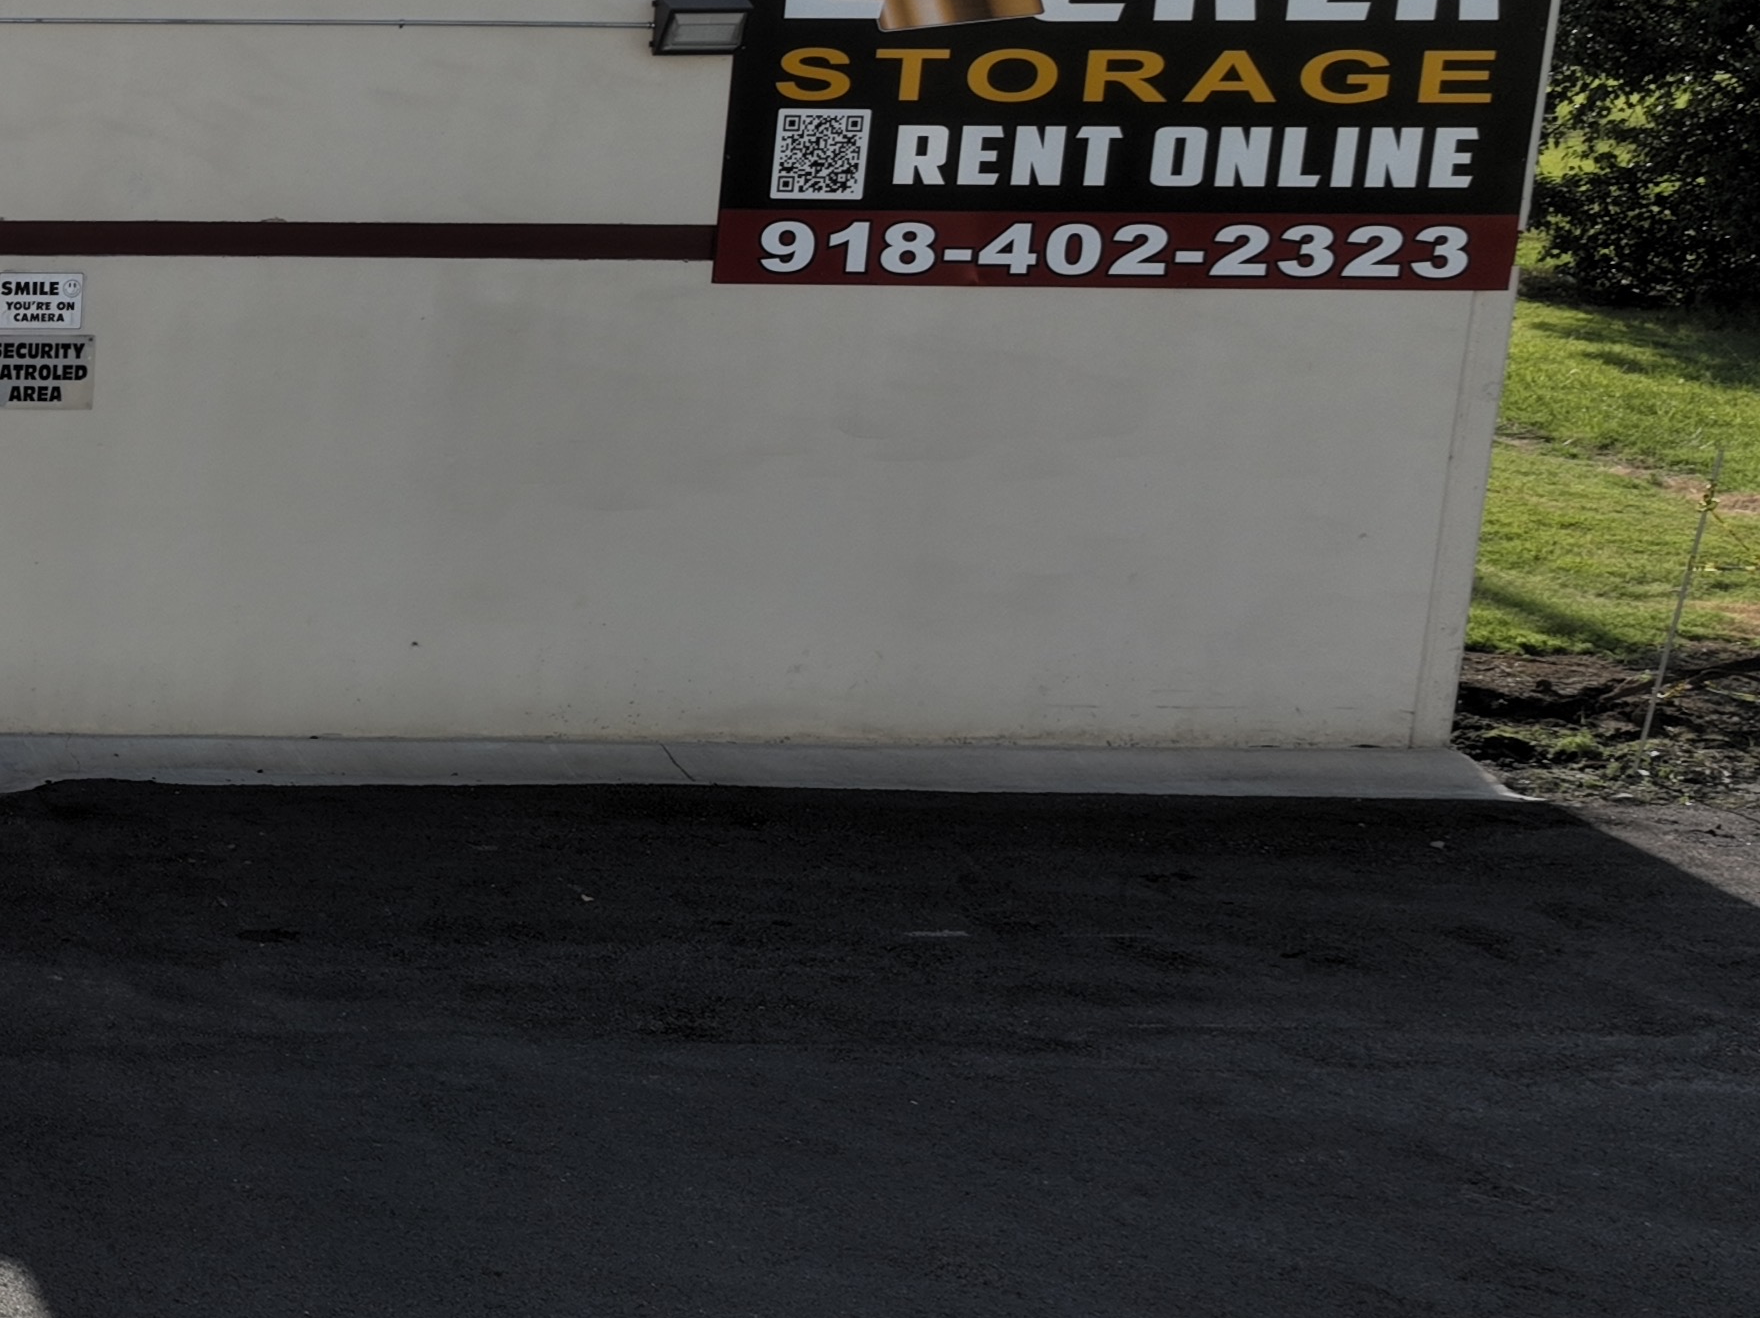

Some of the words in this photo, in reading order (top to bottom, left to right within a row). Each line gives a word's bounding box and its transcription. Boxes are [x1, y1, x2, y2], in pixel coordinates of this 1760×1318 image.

[776, 47, 1498, 104] STORAGE
[891, 124, 1124, 187] RENT
[1149, 125, 1480, 189] ONLINE
[759, 219, 1470, 279] 918-402-2323
[1, 280, 60, 296] SMILE
[6, 300, 52, 311] YOU'RE
[56, 301, 75, 311] ON
[13, 312, 65, 323] CAMERA
[8, 385, 62, 402] AREA
